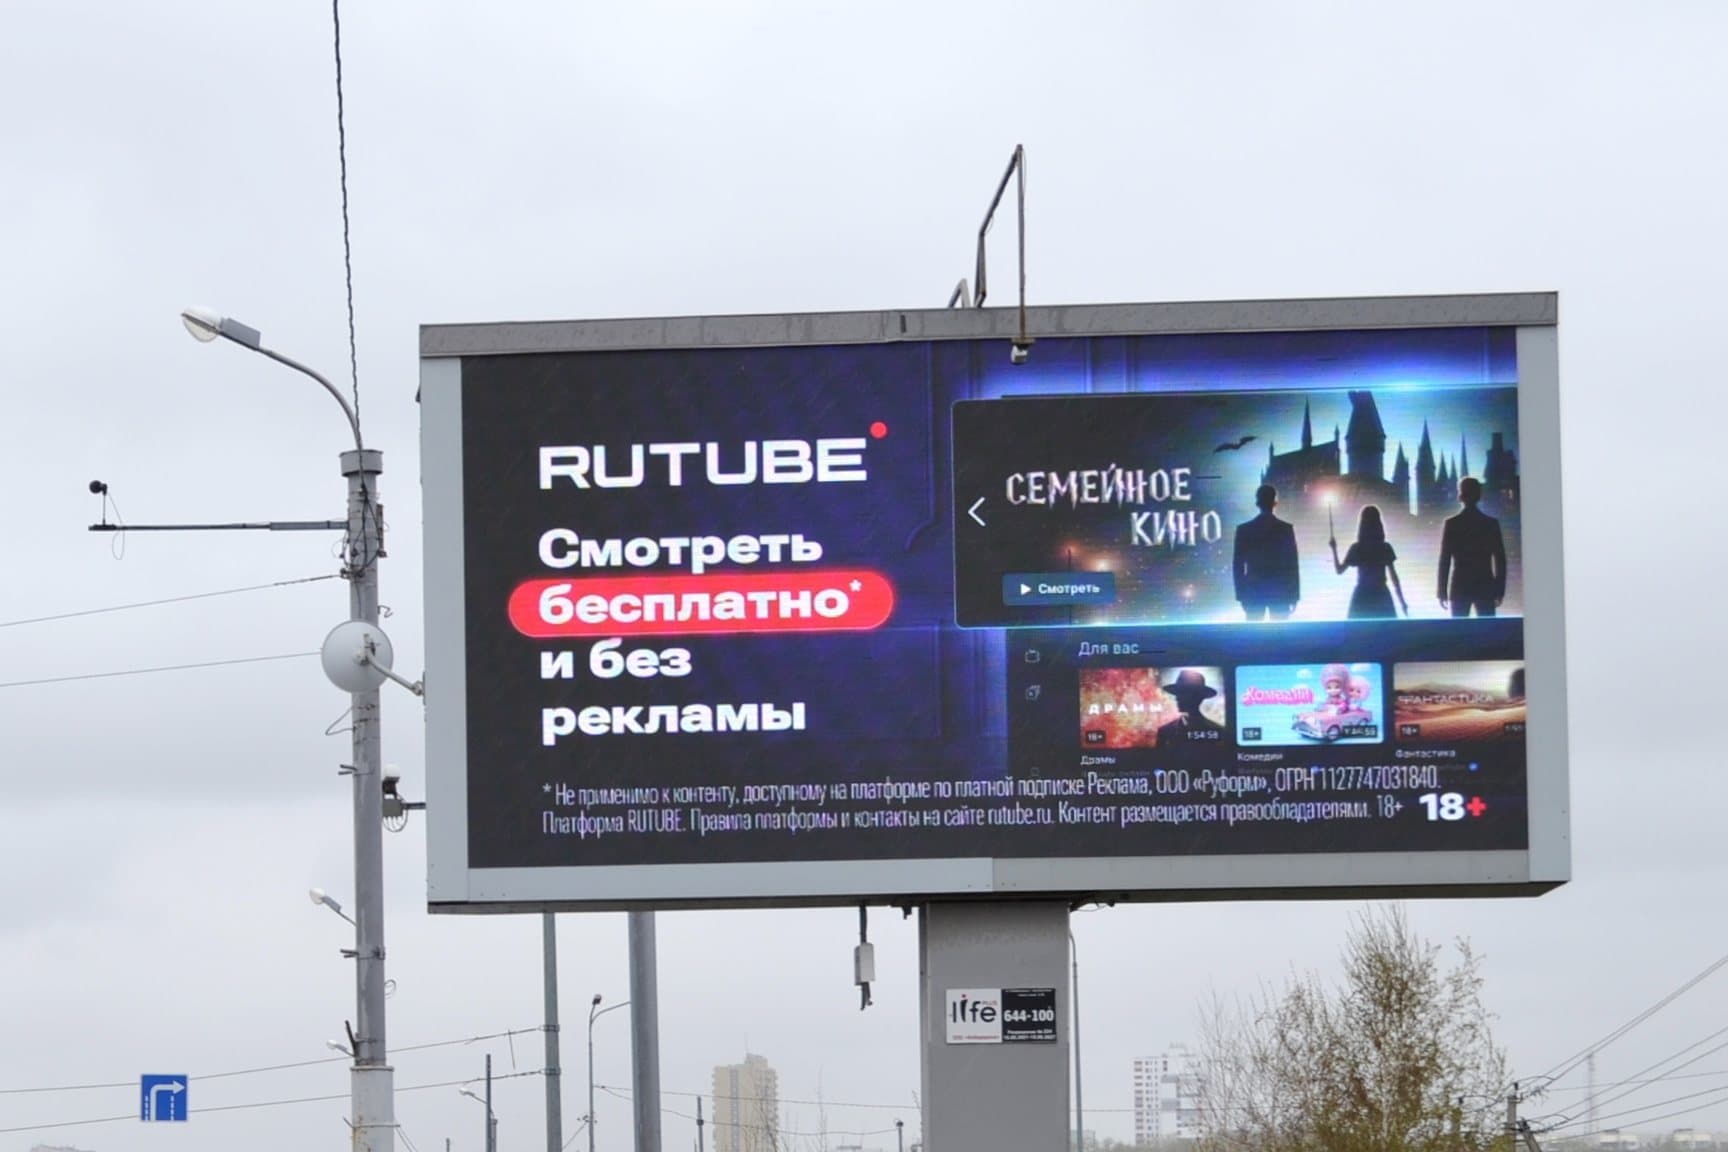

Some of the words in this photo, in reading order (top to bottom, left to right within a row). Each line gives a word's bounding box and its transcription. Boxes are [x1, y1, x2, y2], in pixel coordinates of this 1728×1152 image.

[539, 438, 867, 489] RUTUBE
[1006, 463, 1192, 510] СЕМЕЙНОЕ
[1130, 508, 1223, 549] КИНО
[539, 528, 823, 574] Смотреть
[1038, 582, 1101, 597] Смотреть
[540, 651, 574, 679] и
[589, 637, 693, 678] без
[1078, 641, 1109, 656] Для
[1113, 641, 1140, 655] вас
[542, 702, 806, 746] рекламы
[555, 784, 575, 805] Не
[578, 786, 658, 809] применимо
[662, 790, 670, 803] к
[673, 785, 740, 808] контенту,
[743, 783, 827, 806] доступному
[831, 784, 846, 800] на
[851, 776, 930, 804] платформе
[934, 780, 952, 798] по
[956, 776, 1014, 797] платной
[1018, 777, 1085, 799] подписке
[1087, 771, 1153, 797] Реклама,
[1156, 769, 1189, 794] ООО
[1193, 767, 1272, 799] «Руформ»,
[1275, 767, 1315, 791] ОГРН
[1321, 764, 1442, 790] 1127747031840.
[1419, 792, 1487, 822] 18+
[543, 810, 623, 840] Платформа
[628, 808, 687, 832] RUTUBE.
[691, 808, 751, 837] Правила
[755, 807, 838, 836] платформы
[841, 811, 850, 827] и
[854, 808, 921, 829] контакты
[924, 808, 941, 826] на
[944, 804, 985, 826] сайте
[988, 802, 1056, 825] rutube.ru.
[1059, 800, 1117, 825] Контент
[1121, 800, 1217, 828] размещается
[1220, 796, 1371, 826] правообладателями.
[1377, 794, 1404, 819] 18+
[1004, 1009, 1054, 1022] 644-100
